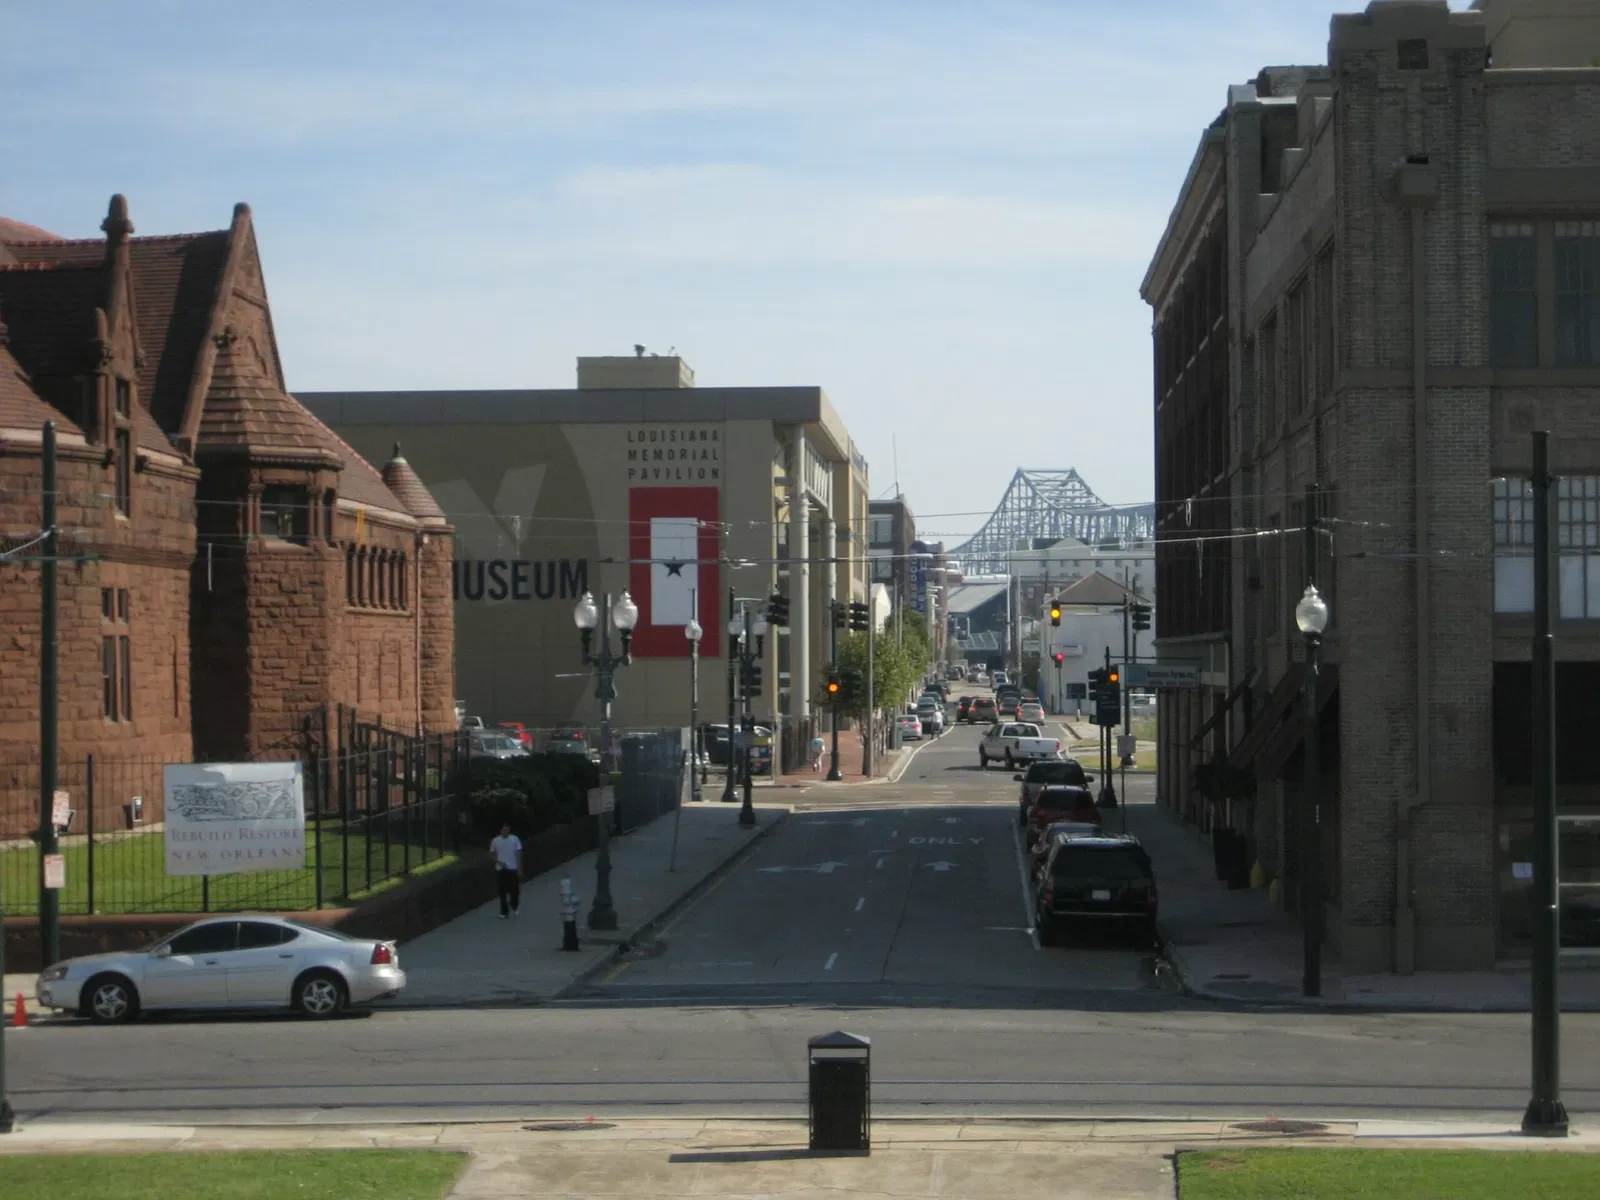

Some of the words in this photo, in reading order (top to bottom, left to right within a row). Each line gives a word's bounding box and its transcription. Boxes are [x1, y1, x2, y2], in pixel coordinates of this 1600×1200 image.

[627, 429, 718, 442] LOUISIANA
[627, 448, 719, 461] MEMORIAL
[627, 467, 719, 480] PAVILION
[453, 558, 588, 601] USEUM
[908, 836, 984, 845] ONLY
[172, 850, 210, 861] NEW
[220, 847, 303, 860] ORLEANS
